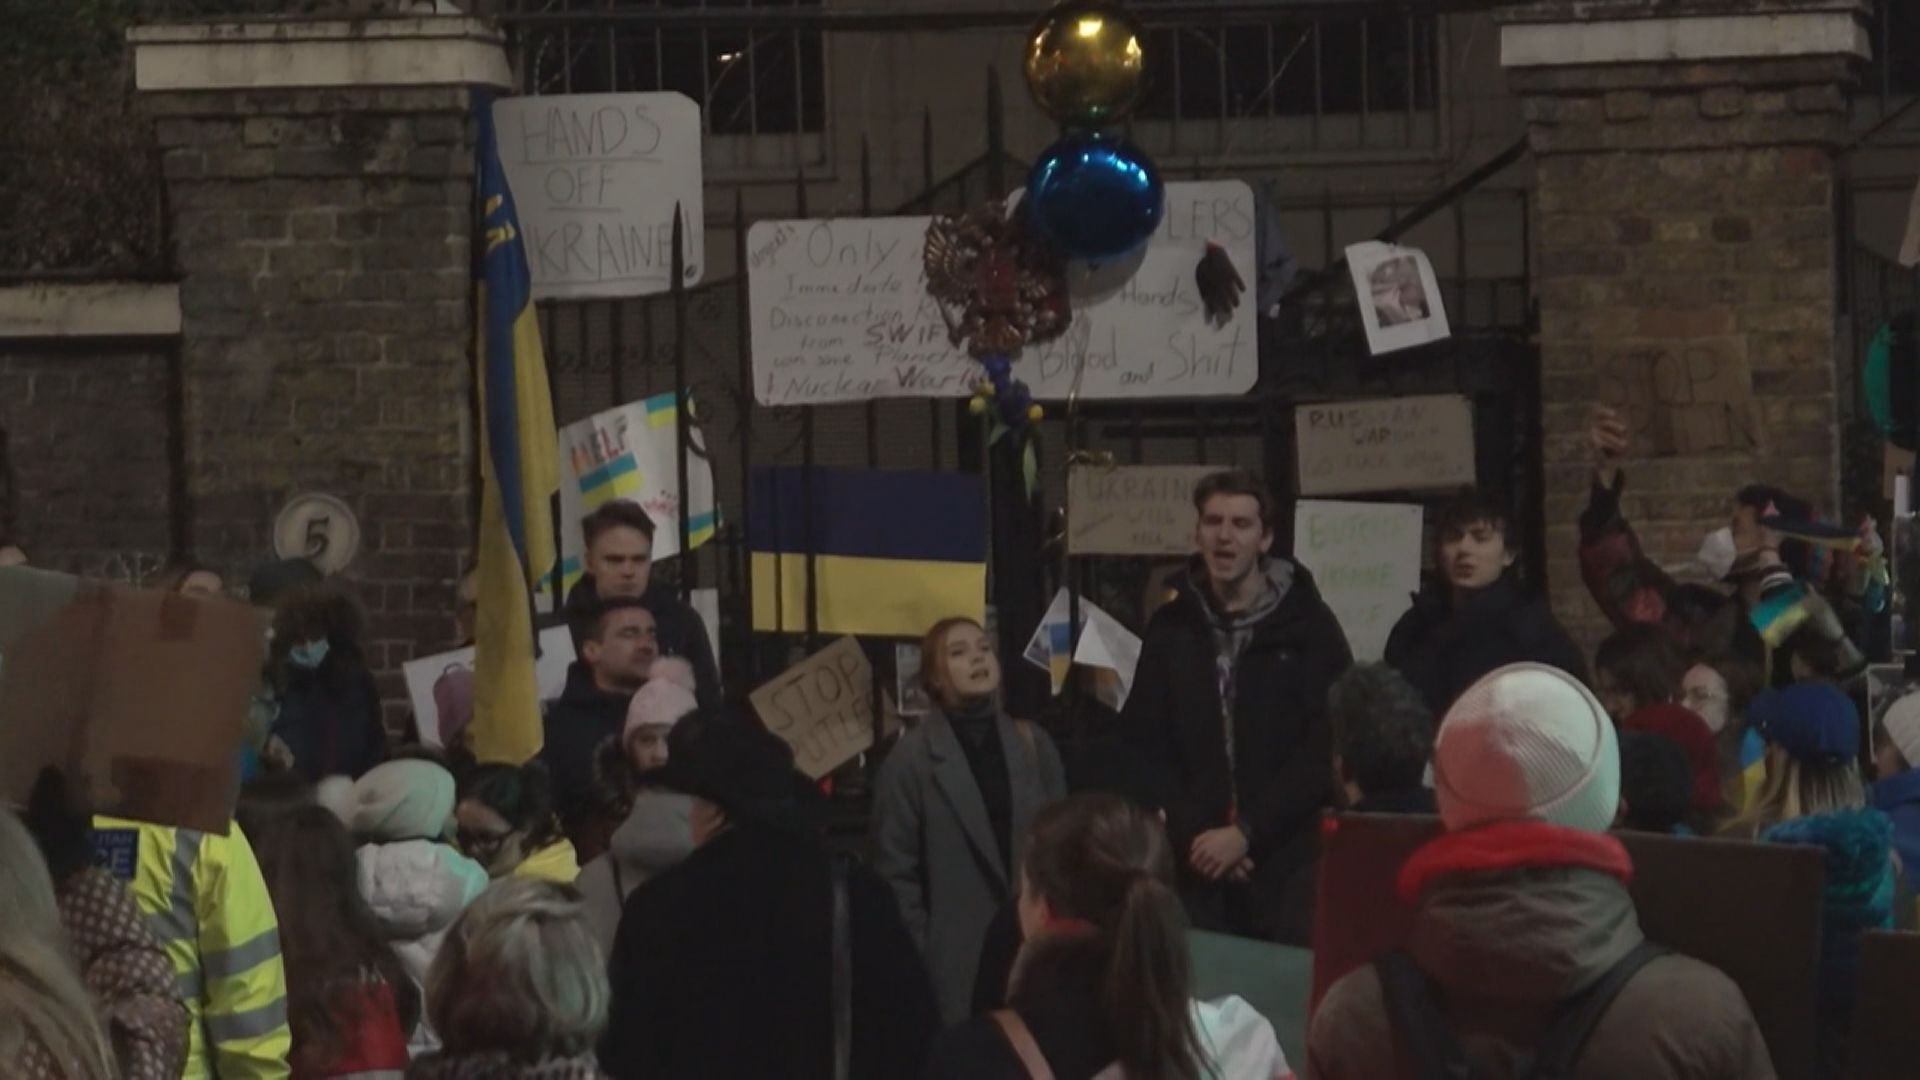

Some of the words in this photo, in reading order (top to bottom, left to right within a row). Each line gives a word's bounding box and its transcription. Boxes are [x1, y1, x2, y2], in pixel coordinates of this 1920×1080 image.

[519, 104, 663, 163] HANDS
[544, 164, 617, 206] OFF
[526, 207, 699, 281] KRAINE!
[1168, 197, 1251, 244] LERS
[806, 222, 899, 274] Only
[1120, 275, 1198, 317] Hands
[1038, 325, 1118, 382] Blood
[1120, 362, 1154, 385] and
[1166, 325, 1249, 383] Shit
[784, 369, 887, 399] Nuclear
[305, 516, 330, 560] 5
[769, 652, 859, 731] STOP
